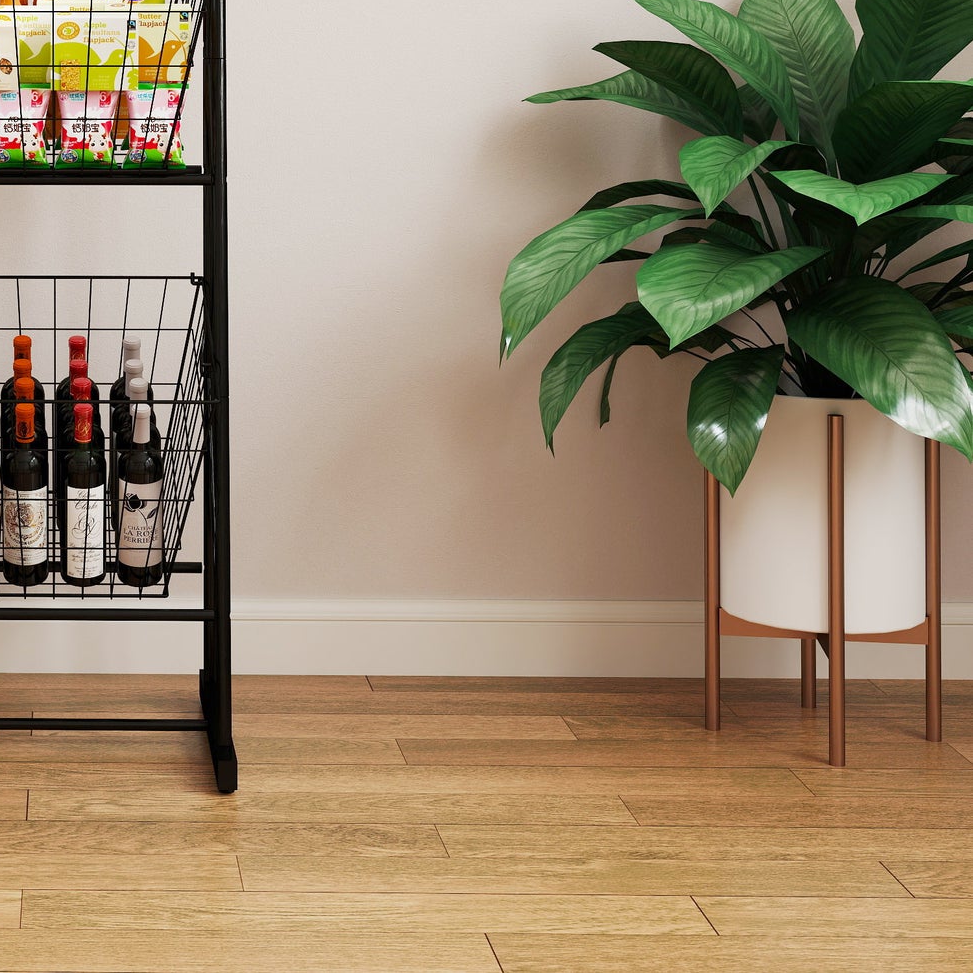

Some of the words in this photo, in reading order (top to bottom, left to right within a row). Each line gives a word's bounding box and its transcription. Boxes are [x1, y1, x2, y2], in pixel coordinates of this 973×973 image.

[31, 91, 39, 102] 6
[100, 91, 107, 102] 6
[169, 91, 176, 102] 6
